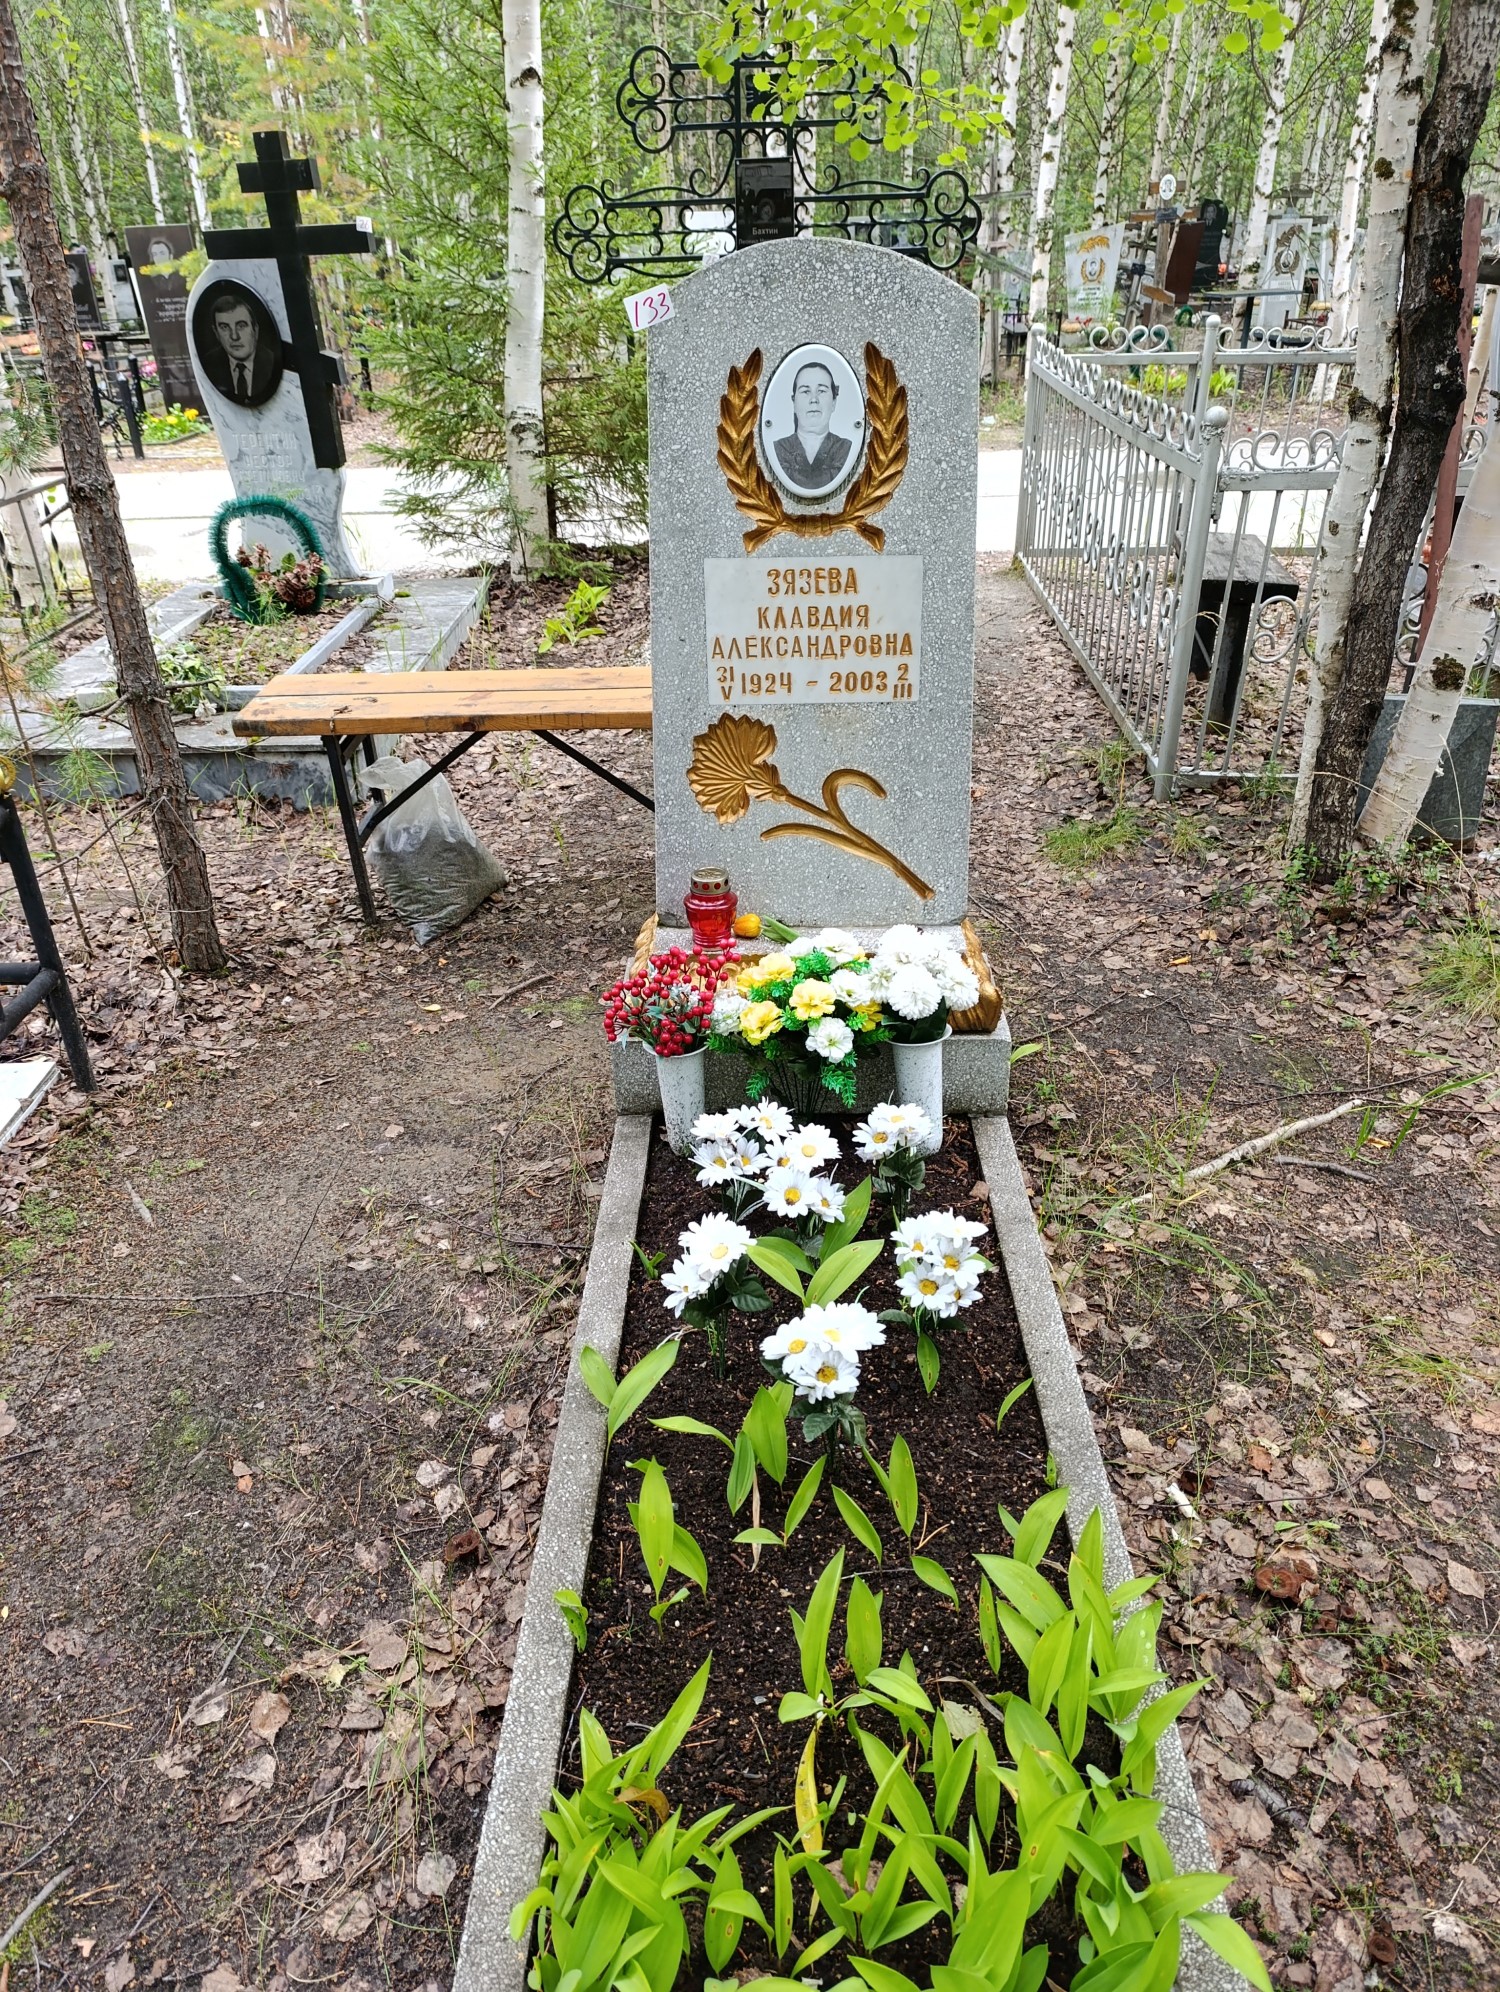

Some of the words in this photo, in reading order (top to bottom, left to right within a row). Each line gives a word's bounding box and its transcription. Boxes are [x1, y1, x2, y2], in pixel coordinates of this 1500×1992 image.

[752, 226, 779, 236] Бахтин
[634, 292, 671, 328] 133
[766, 566, 860, 597] ЗЯЗЕВА
[757, 604, 870, 631] КЛАВДИЯ
[711, 632, 914, 660] АЛЕКСАНДРОВНА
[716, 666, 735, 684] 31
[740, 671, 793, 697] 1924
[829, 670, 889, 695] 2003
[897, 663, 910, 682] 2
[720, 685, 733, 702] V
